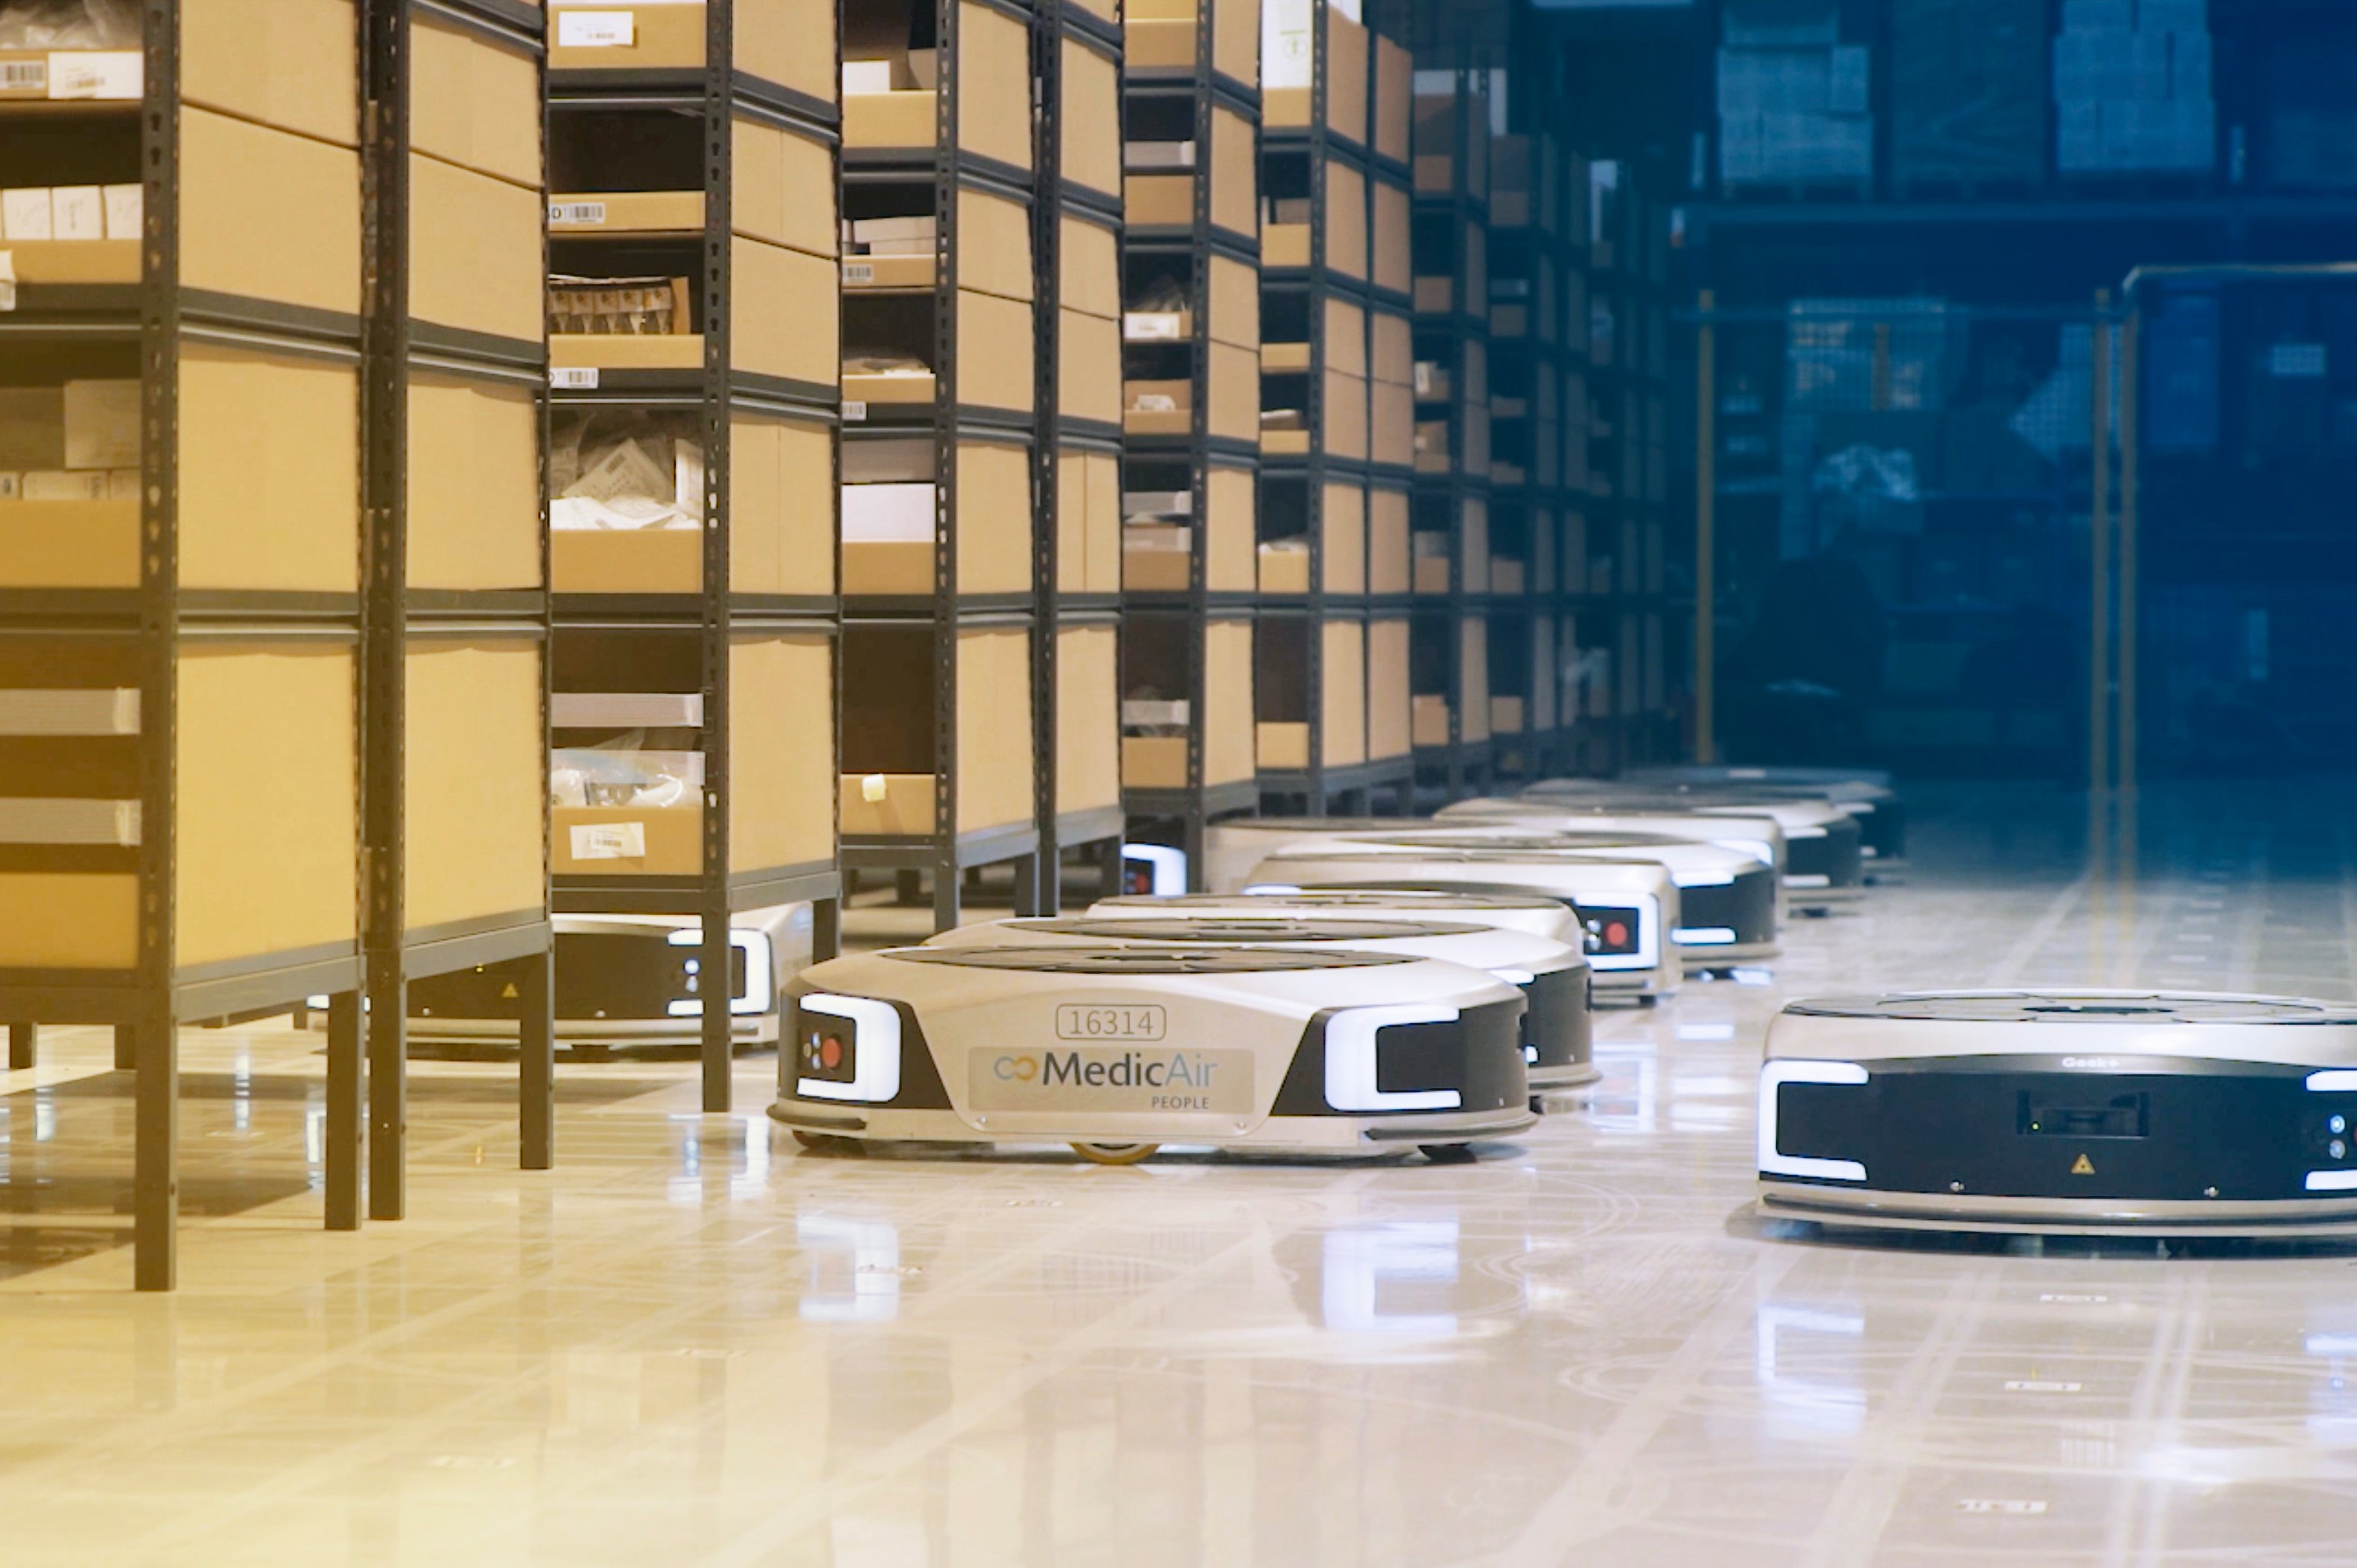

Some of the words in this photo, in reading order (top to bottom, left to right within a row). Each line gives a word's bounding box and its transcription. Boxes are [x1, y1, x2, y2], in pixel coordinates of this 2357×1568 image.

[1070, 1010, 1153, 1035] 16314
[1043, 1052, 1218, 1087] MedicAir
[1151, 1096, 1210, 1110] PEOPLE
